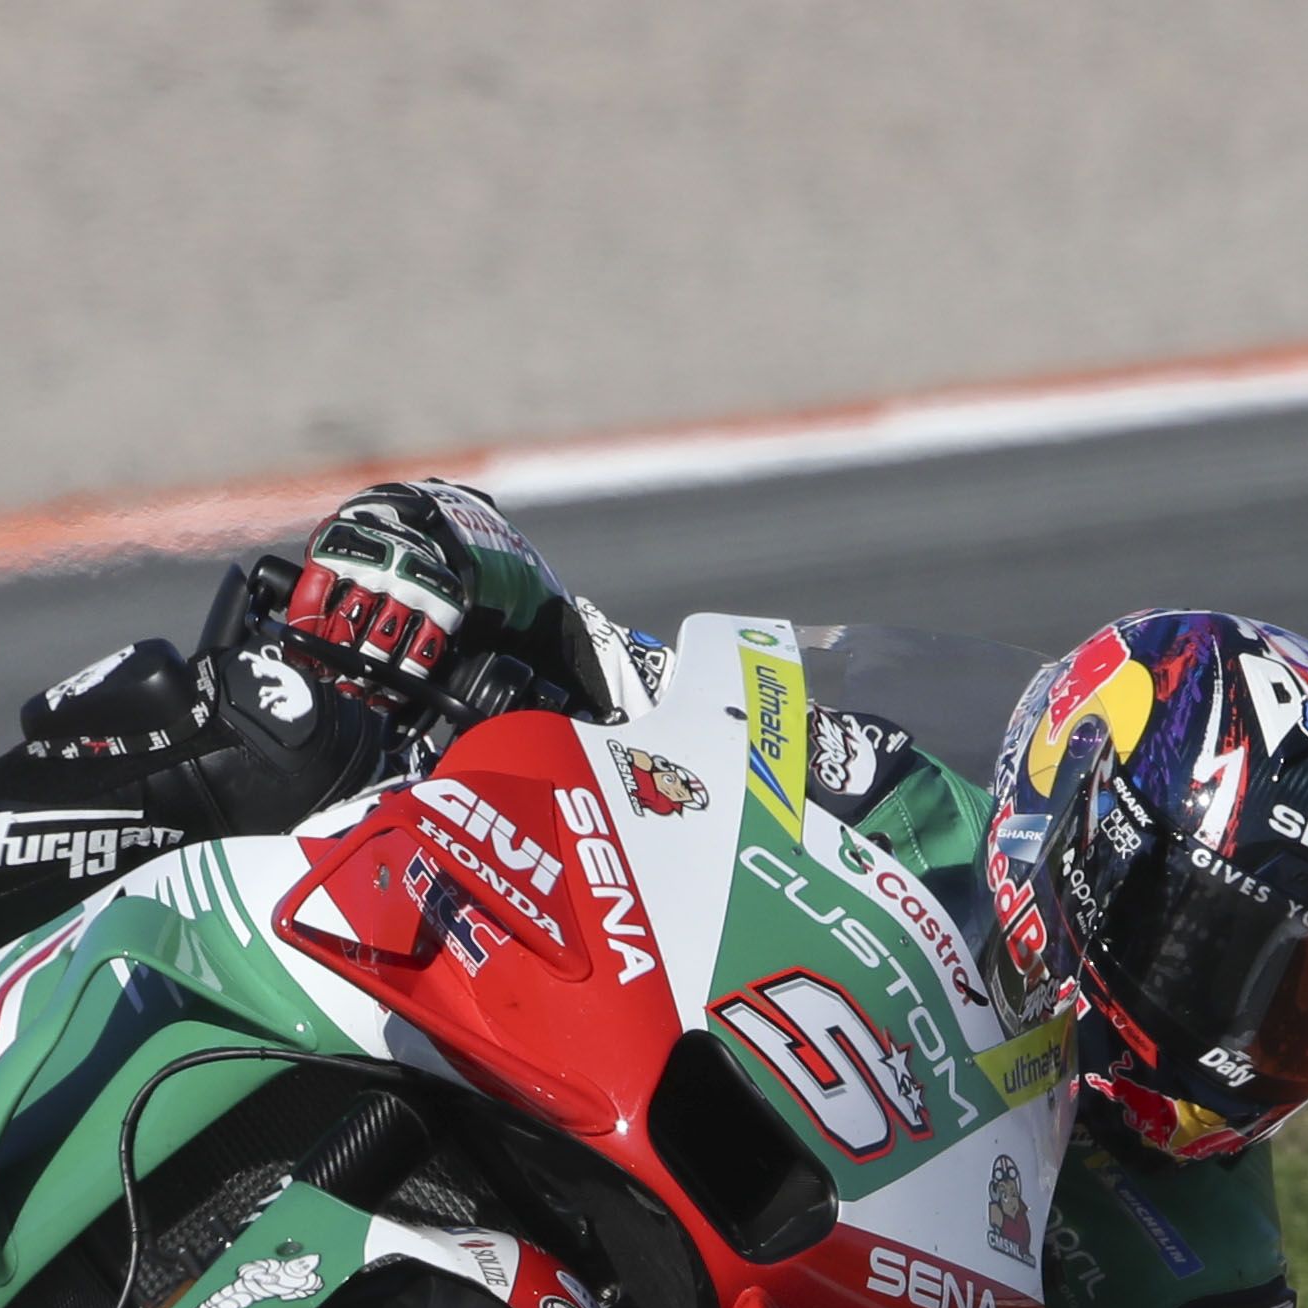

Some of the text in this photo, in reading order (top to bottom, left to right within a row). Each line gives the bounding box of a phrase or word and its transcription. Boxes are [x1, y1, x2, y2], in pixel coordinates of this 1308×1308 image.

[755, 665, 789, 761] ultimate
[410, 778, 563, 896] GIVI
[1113, 776, 1153, 827] SHARK
[417, 816, 565, 947] HONDA
[554, 786, 656, 986] SENA
[1191, 848, 1272, 903] GIVES
[739, 845, 979, 1129] CUSTOM
[1198, 1047, 1257, 1088] Dafy
